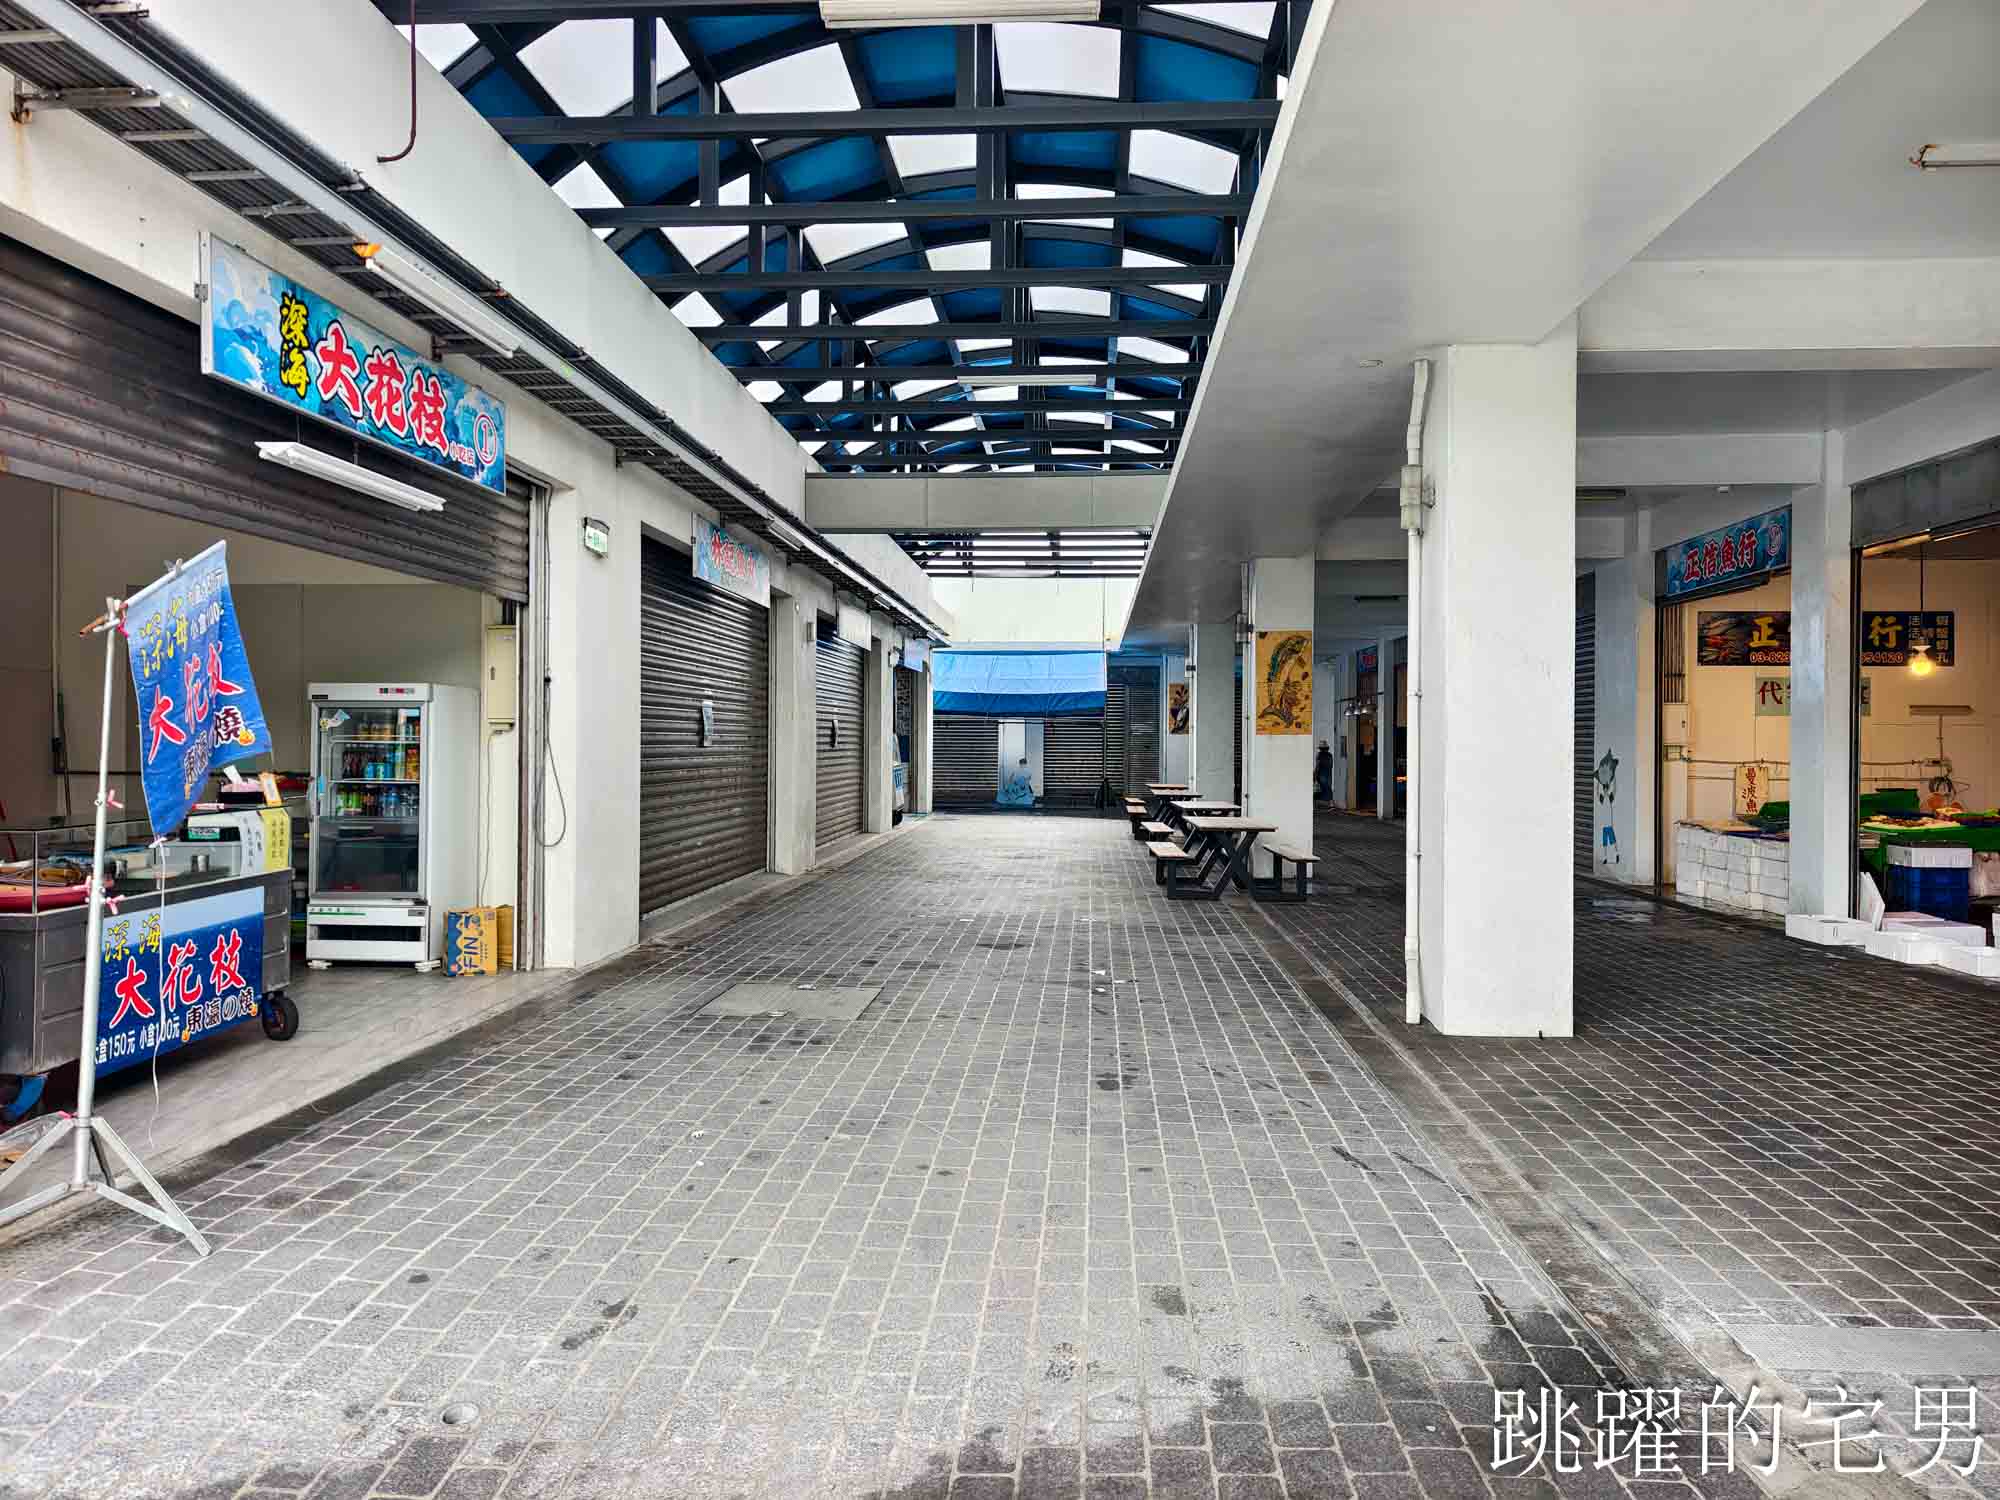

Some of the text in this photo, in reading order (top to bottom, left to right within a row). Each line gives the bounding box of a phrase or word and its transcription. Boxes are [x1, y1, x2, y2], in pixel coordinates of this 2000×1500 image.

[315, 319, 449, 457] 大花枝
[1742, 767, 1758, 813] 曼波魚
[105, 913, 161, 963] 深海
[109, 928, 247, 1029] 大花枝
[95, 1030, 135, 1064] 盒150元
